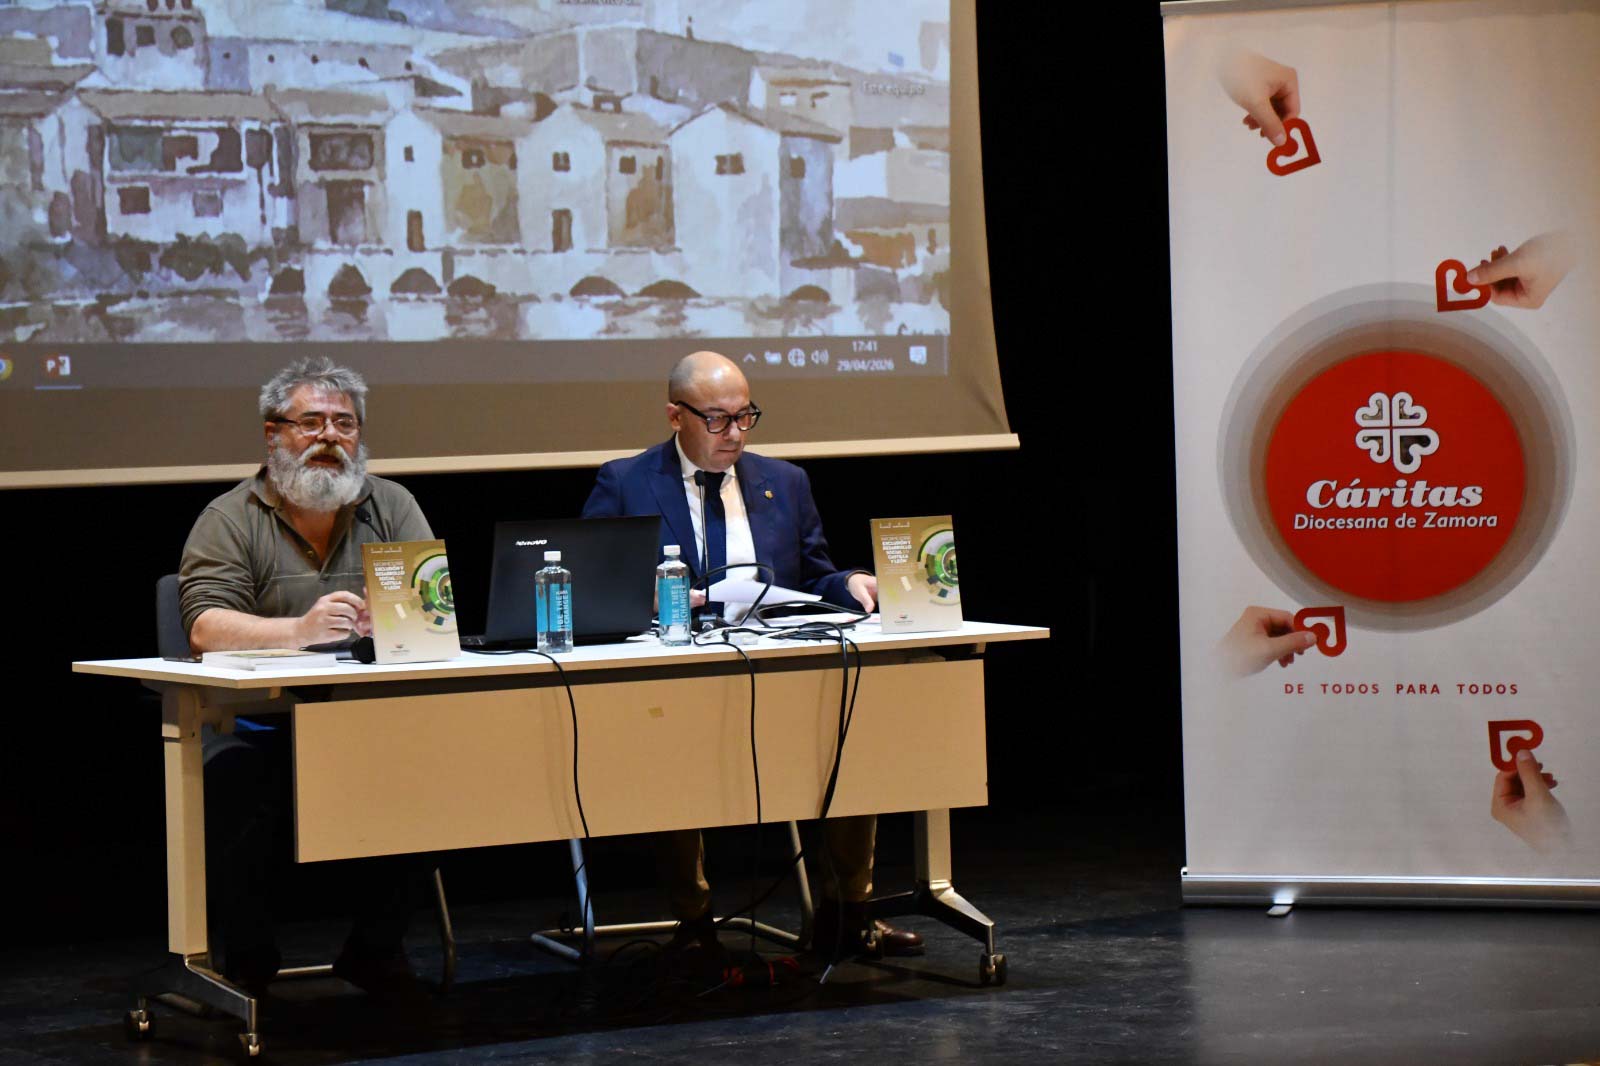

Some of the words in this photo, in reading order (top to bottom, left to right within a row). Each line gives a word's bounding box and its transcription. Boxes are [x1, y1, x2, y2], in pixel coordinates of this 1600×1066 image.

[852, 340, 877, 352] 17:41
[1306, 479, 1483, 509] Cáritas
[1294, 513, 1389, 530] Diocesana
[1394, 512, 1417, 529] de
[1422, 511, 1498, 528] Zamora
[680, 589, 688, 618] CHANGE
[1284, 683, 1303, 694] DE
[1321, 683, 1379, 695] TODOS
[1395, 683, 1441, 694] PARA
[1457, 683, 1517, 695] TODOS
